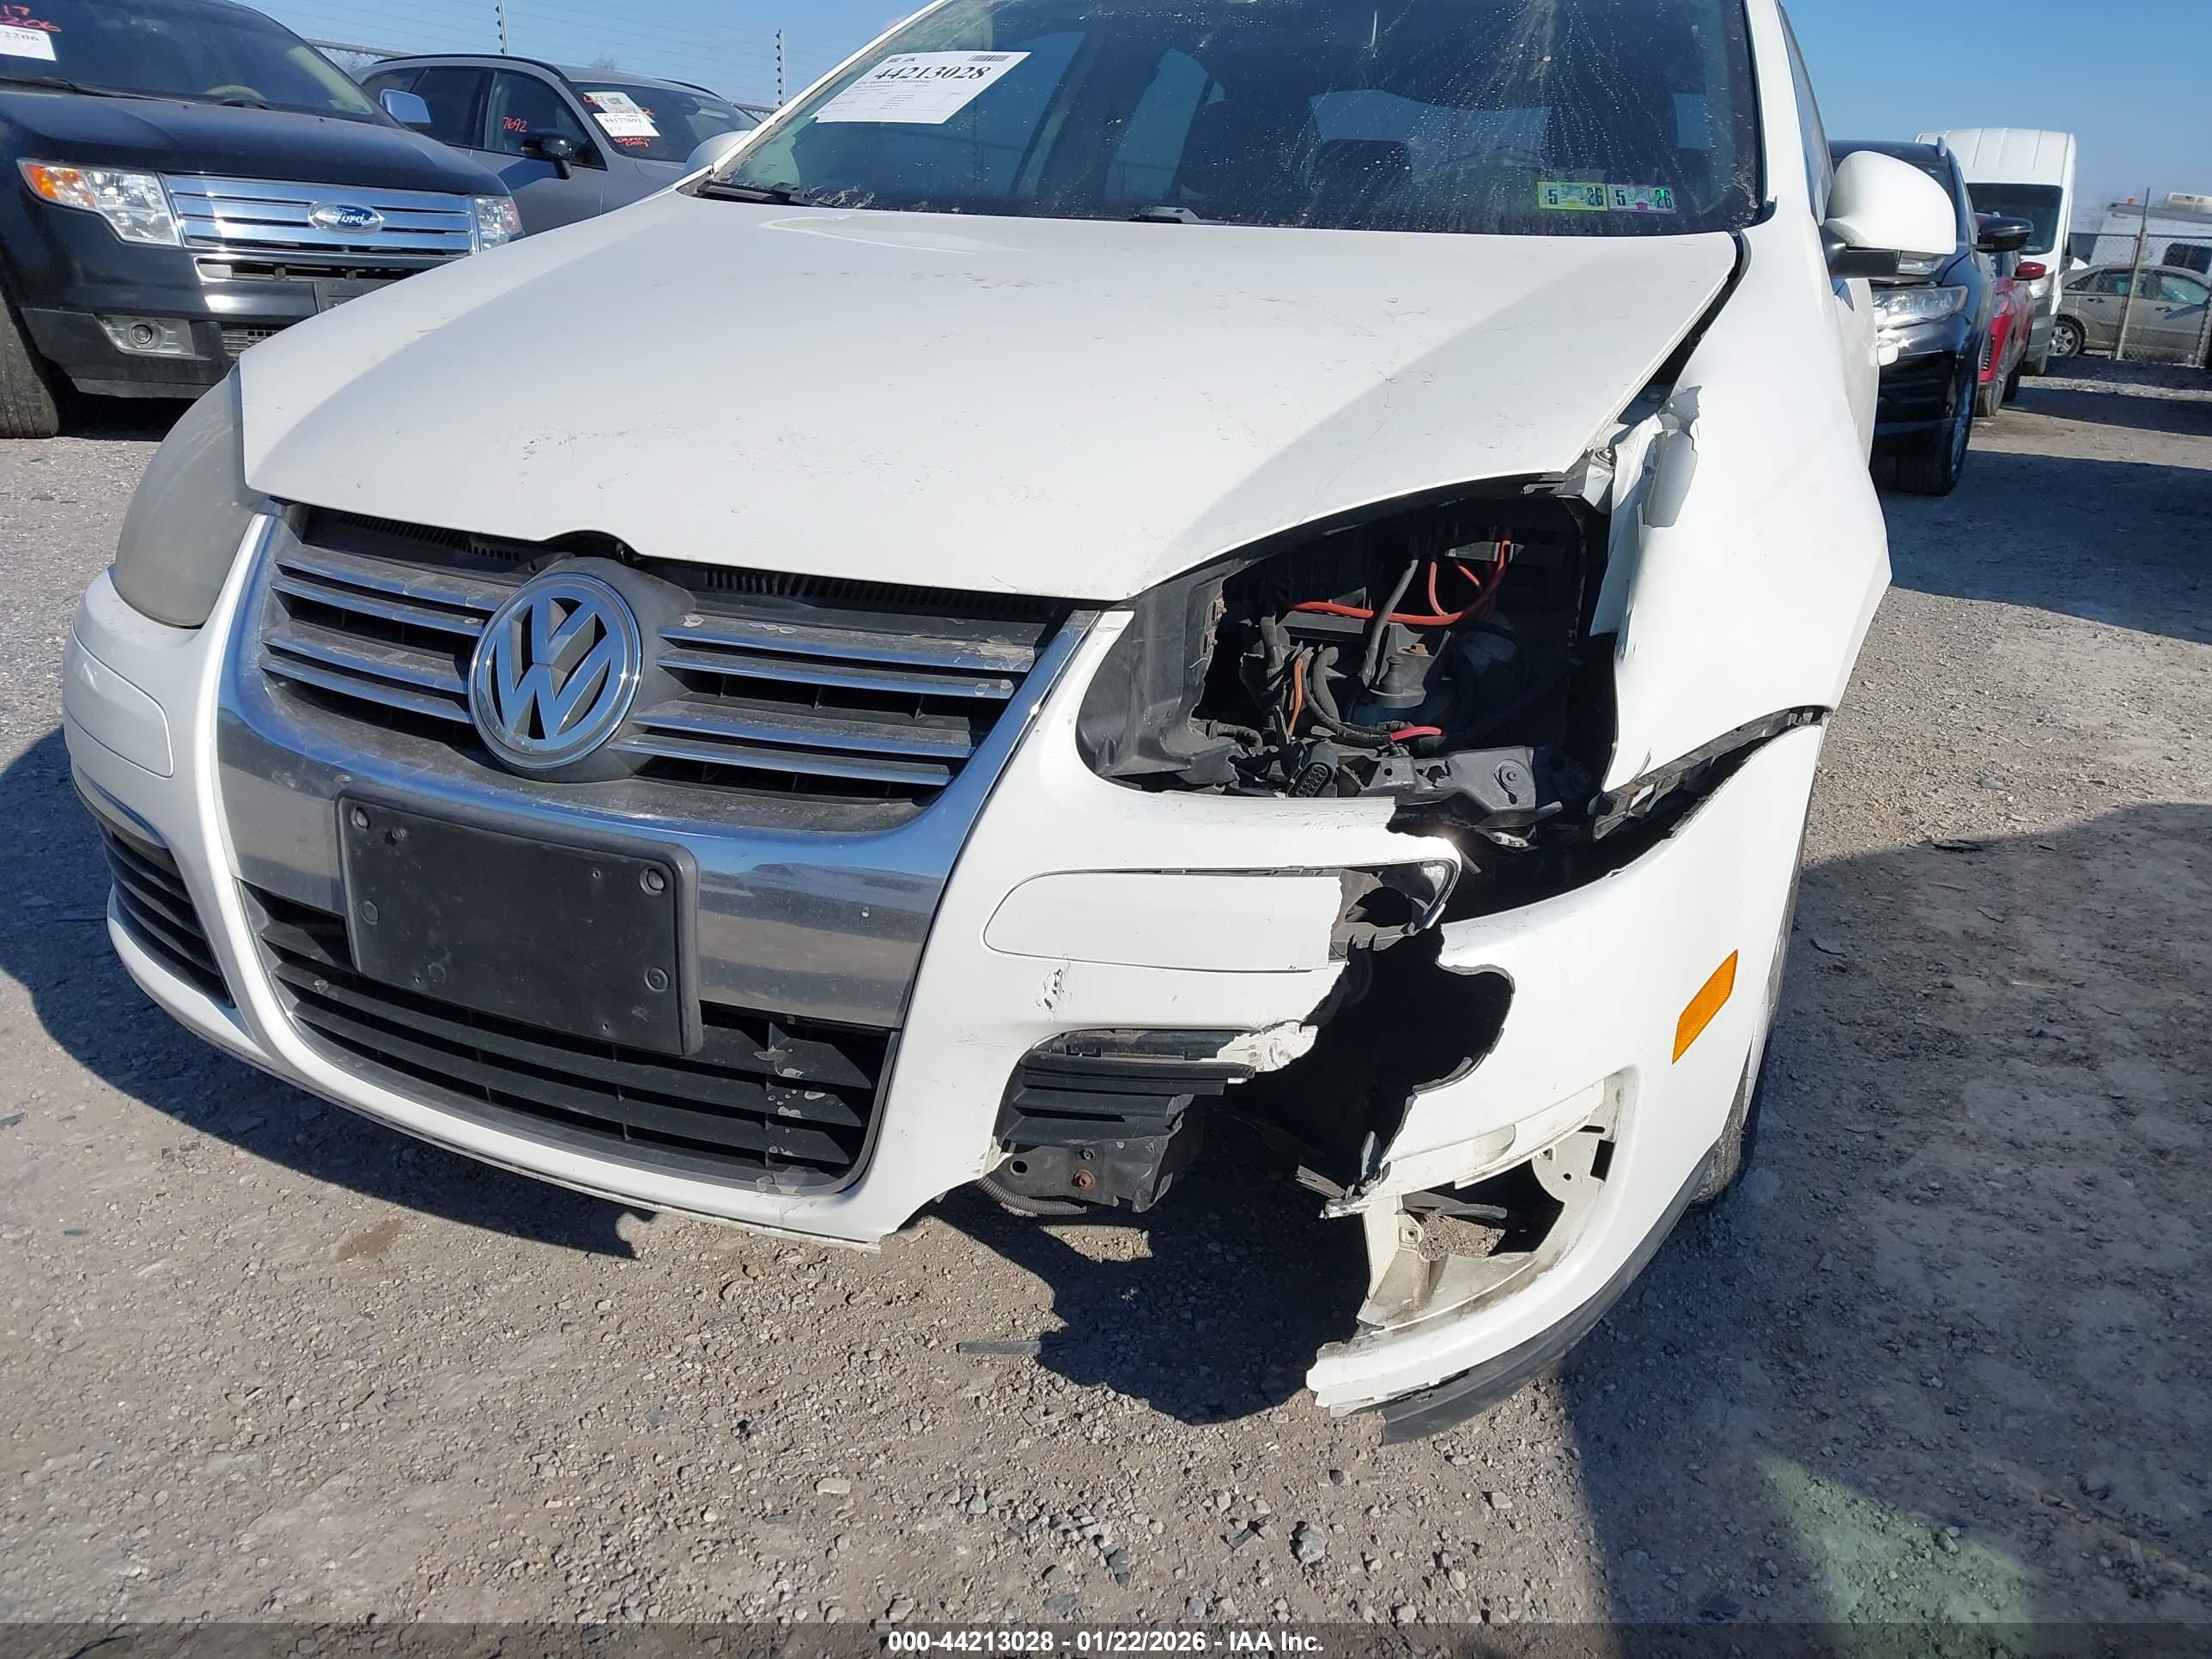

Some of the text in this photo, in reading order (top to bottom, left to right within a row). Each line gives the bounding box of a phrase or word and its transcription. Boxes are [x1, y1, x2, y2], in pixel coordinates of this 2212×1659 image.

[0, 30, 40, 42] 2206
[874, 65, 992, 80] 44213028
[502, 116, 528, 133] 7692
[1547, 186, 1604, 207] 5 26
[1615, 187, 1673, 210] 5 26
[335, 207, 367, 224] Ford
